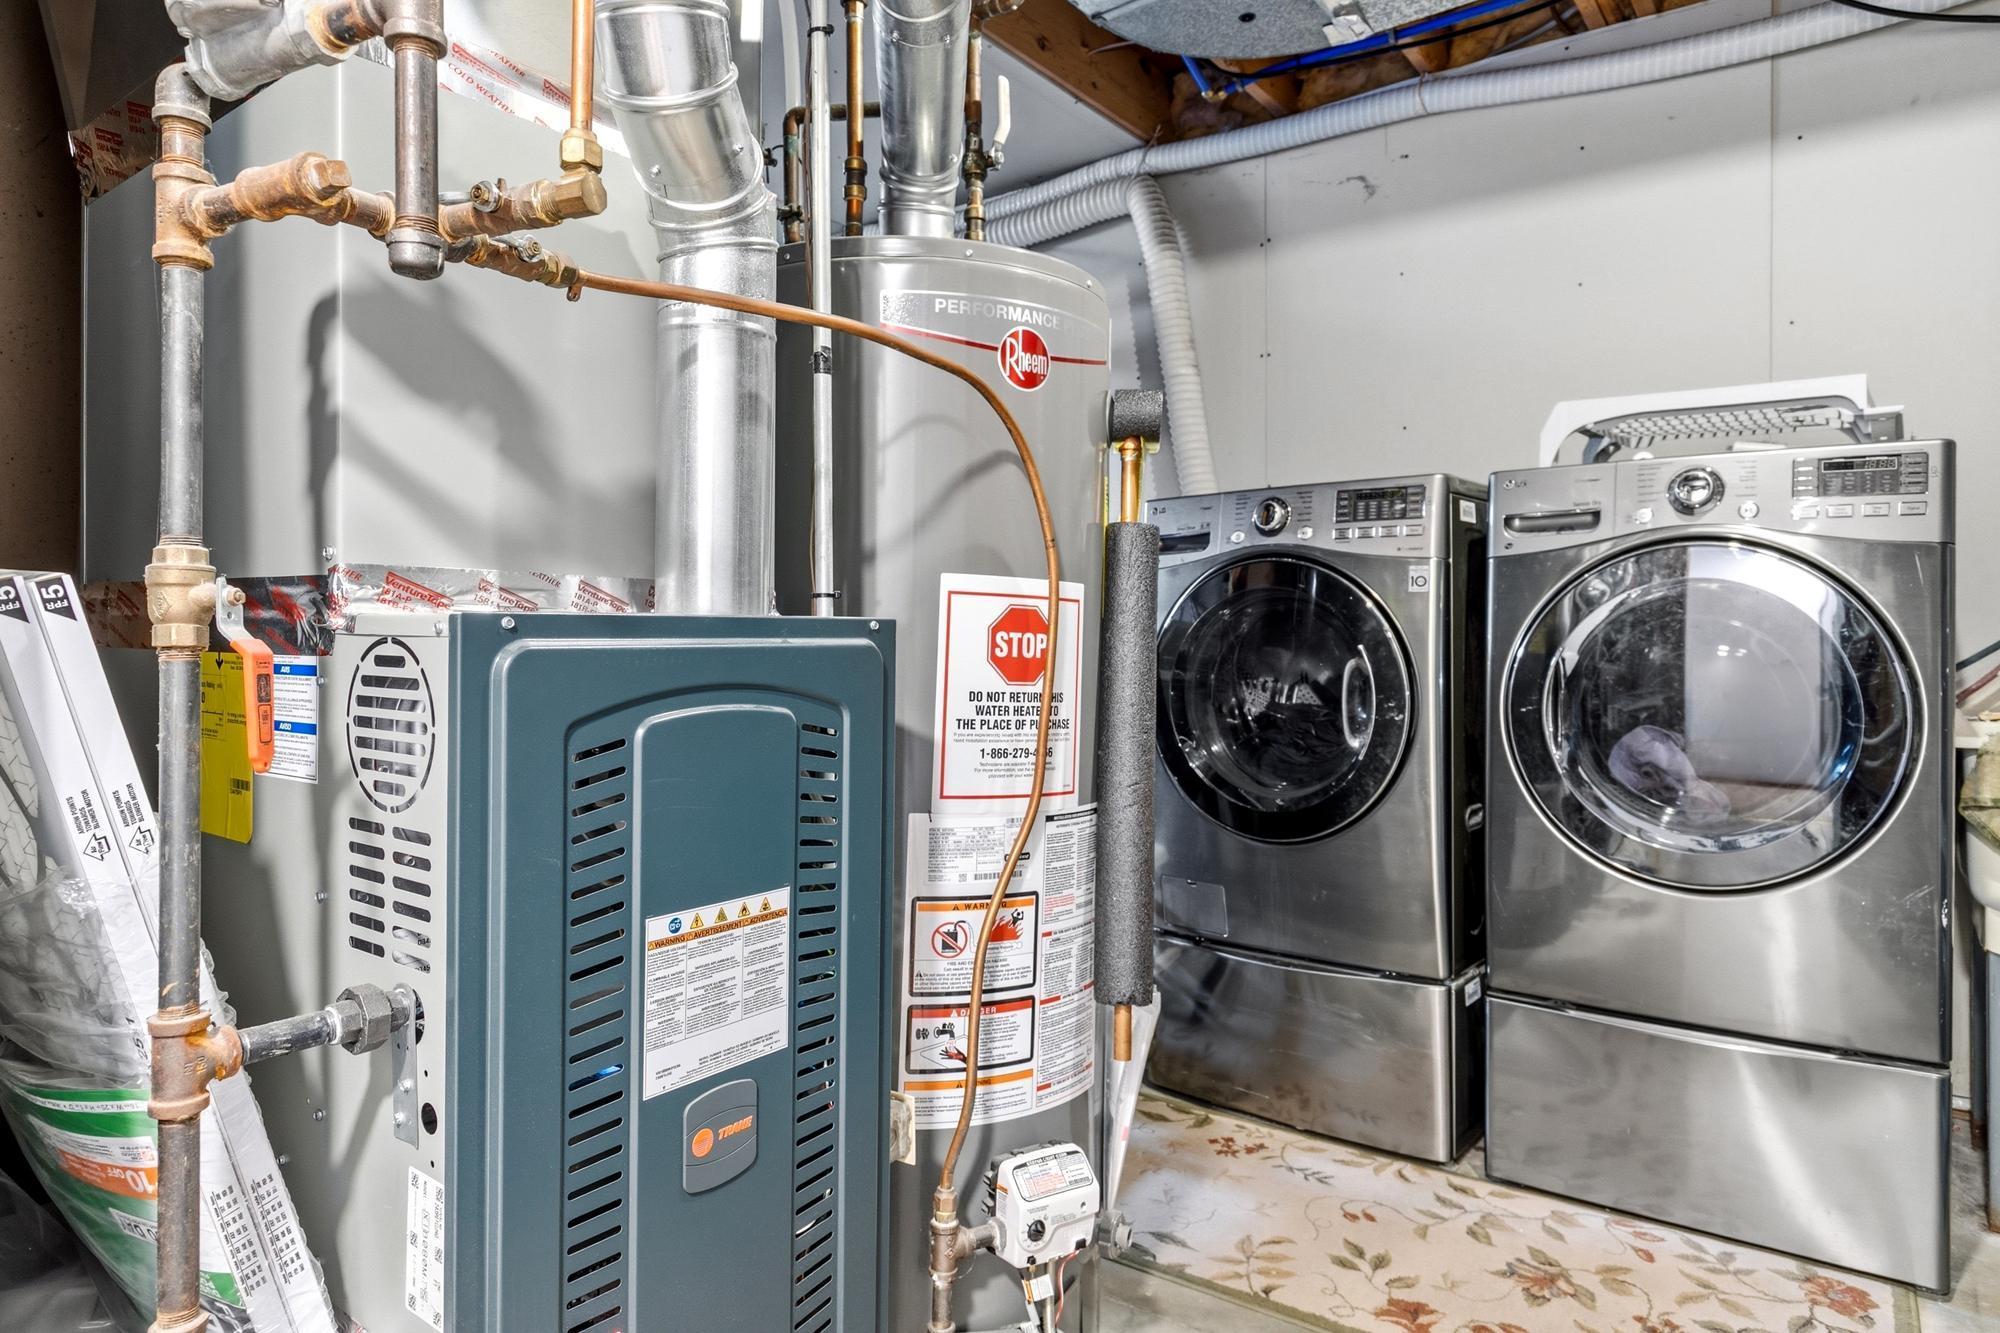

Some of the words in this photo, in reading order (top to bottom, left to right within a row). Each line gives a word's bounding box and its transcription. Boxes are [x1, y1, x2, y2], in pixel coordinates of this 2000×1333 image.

[934, 298, 1060, 330] PERFORMANCE
[1005, 328, 1048, 380] Rheem
[40, 584, 64, 599] 5
[46, 598, 69, 610] FPR
[994, 630, 1048, 659] STOP
[969, 691, 983, 702] DO
[986, 691, 1006, 703] NOT
[975, 705, 1010, 716] WATER
[1013, 705, 1041, 717] HEATE
[955, 718, 976, 730] THE
[980, 719, 1012, 730] PLACE
[1015, 719, 1027, 730] OF
[1030, 719, 1070, 730] PUCHASE
[65, 796, 77, 816] POINTS
[112, 790, 123, 810] POINTS
[964, 902, 1007, 910] WARNG
[654, 934, 686, 948] WARNING
[960, 1006, 997, 1017] DAGER
[717, 1115, 753, 1141] TRANE
